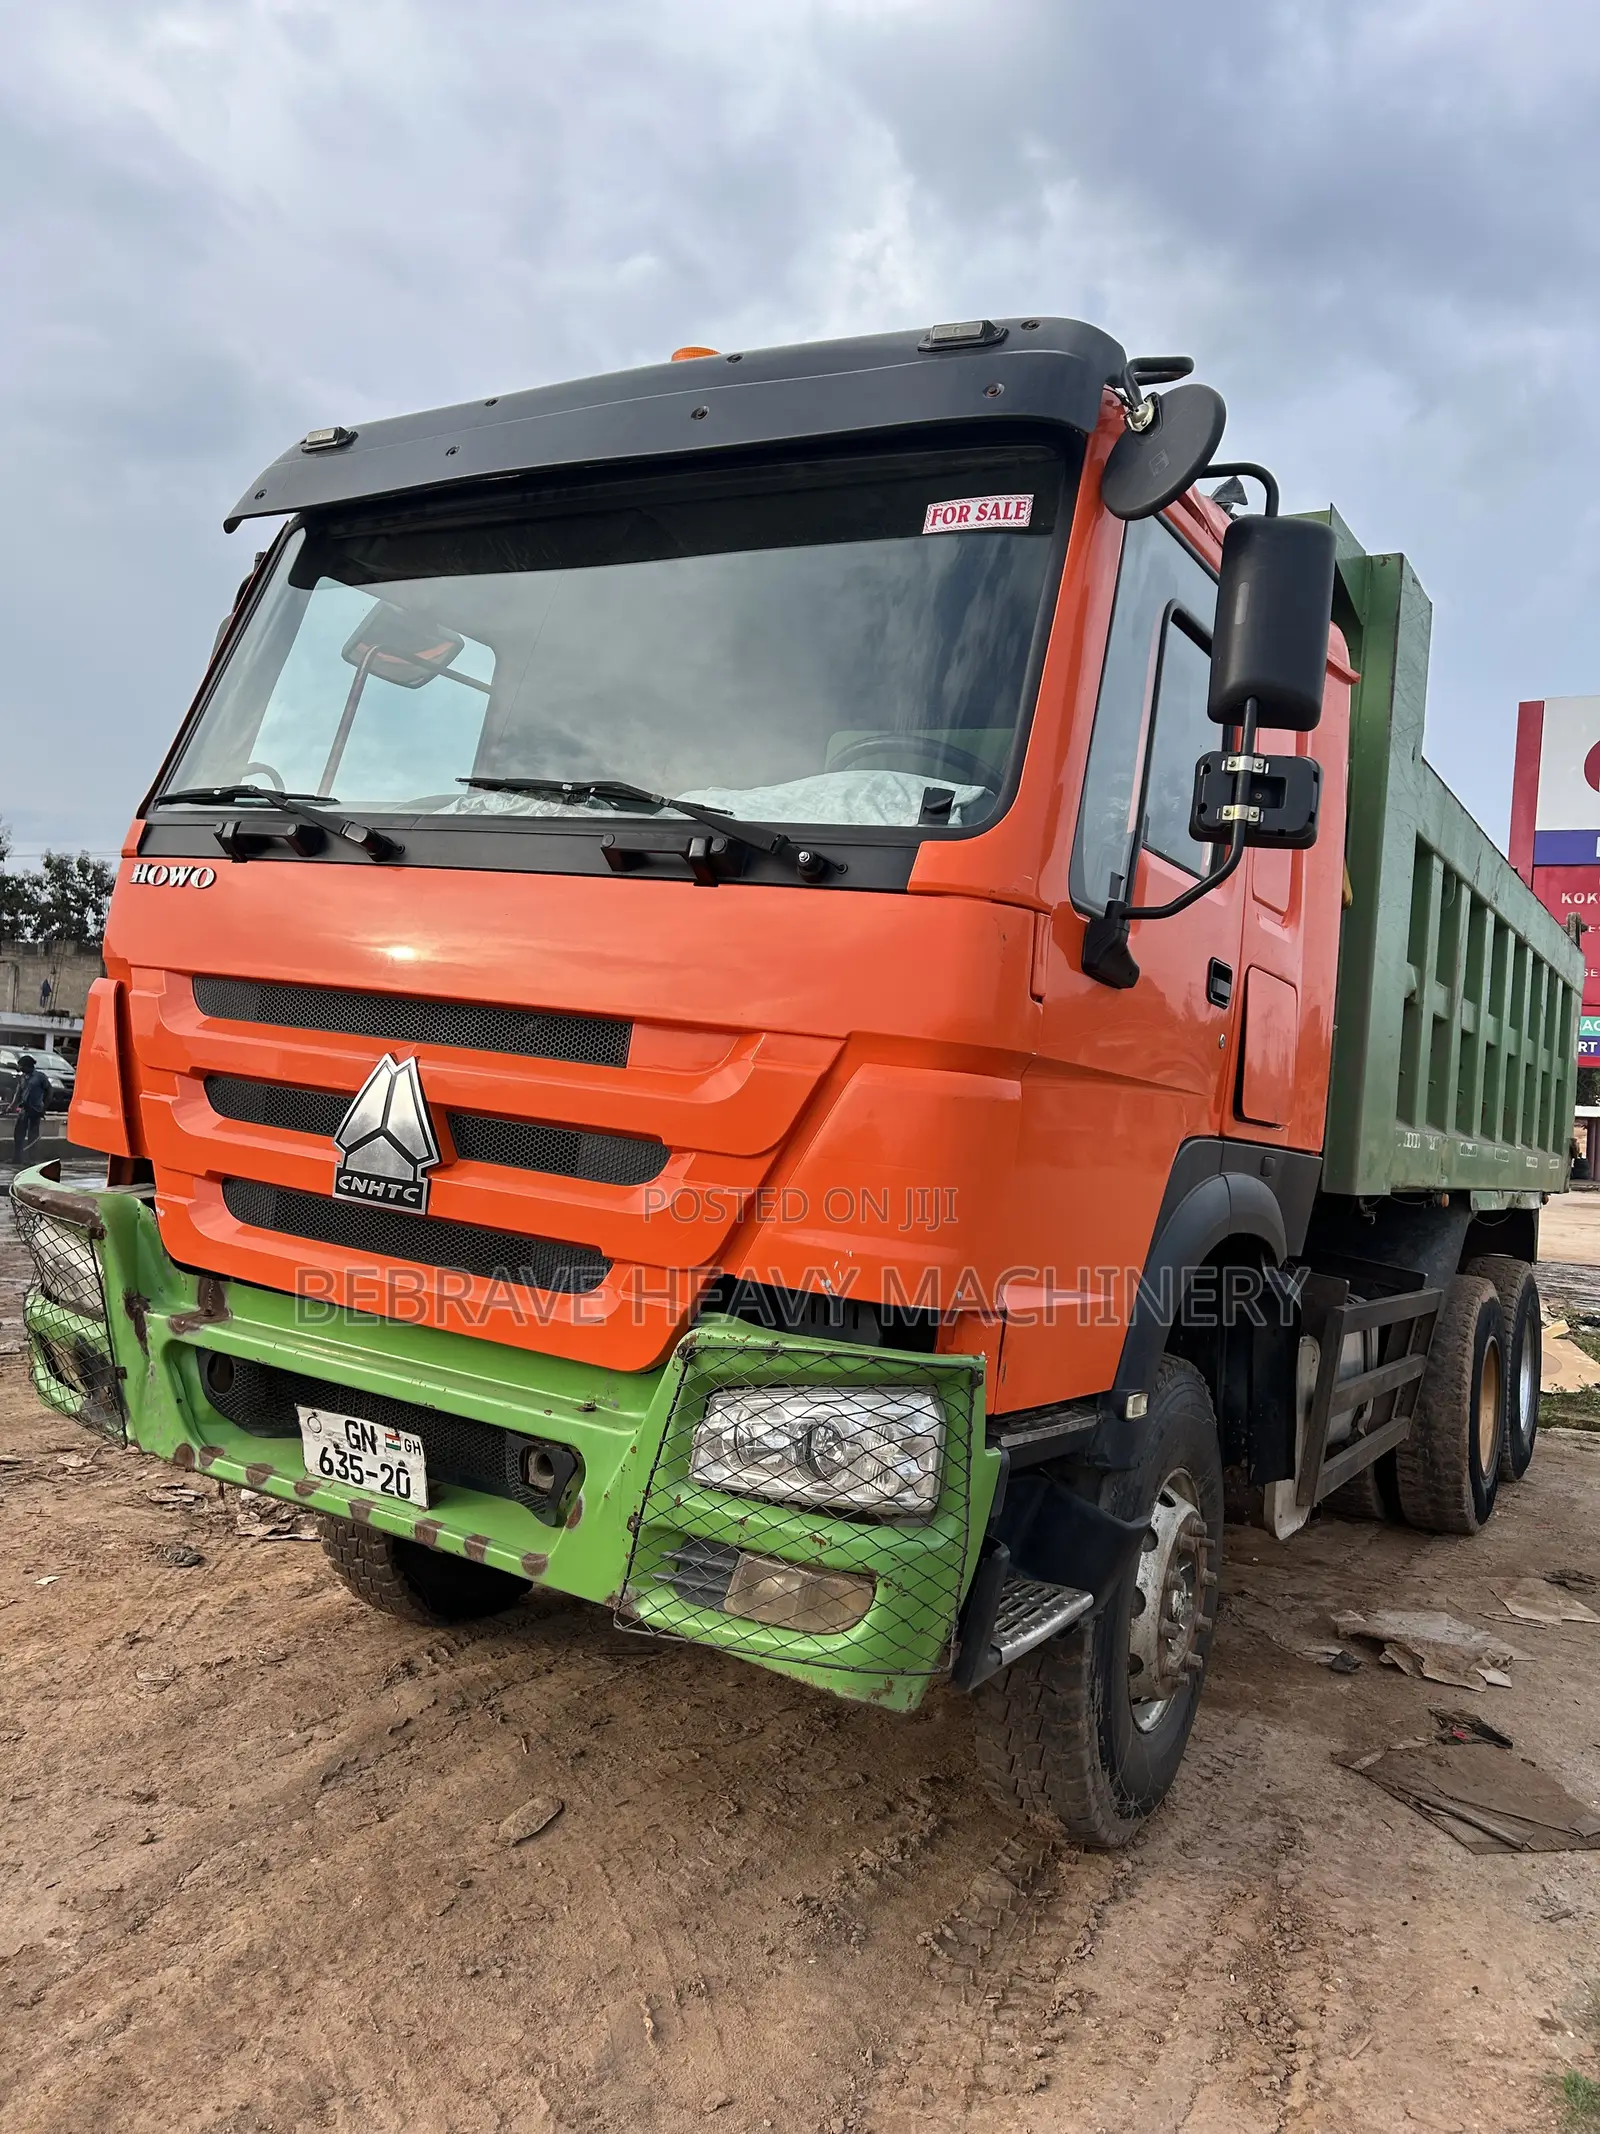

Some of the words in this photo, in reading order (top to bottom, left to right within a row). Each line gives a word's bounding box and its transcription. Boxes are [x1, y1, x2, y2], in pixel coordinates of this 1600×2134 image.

[930, 505, 971, 526] FOR
[975, 501, 1027, 521] SALE
[129, 863, 216, 889] HOWO
[1561, 892, 1600, 904] KOK
[338, 1175, 420, 1202] CNHTC
[344, 1419, 378, 1456] GN
[404, 1438, 422, 1456] GH
[319, 1446, 411, 1500] 635-20
